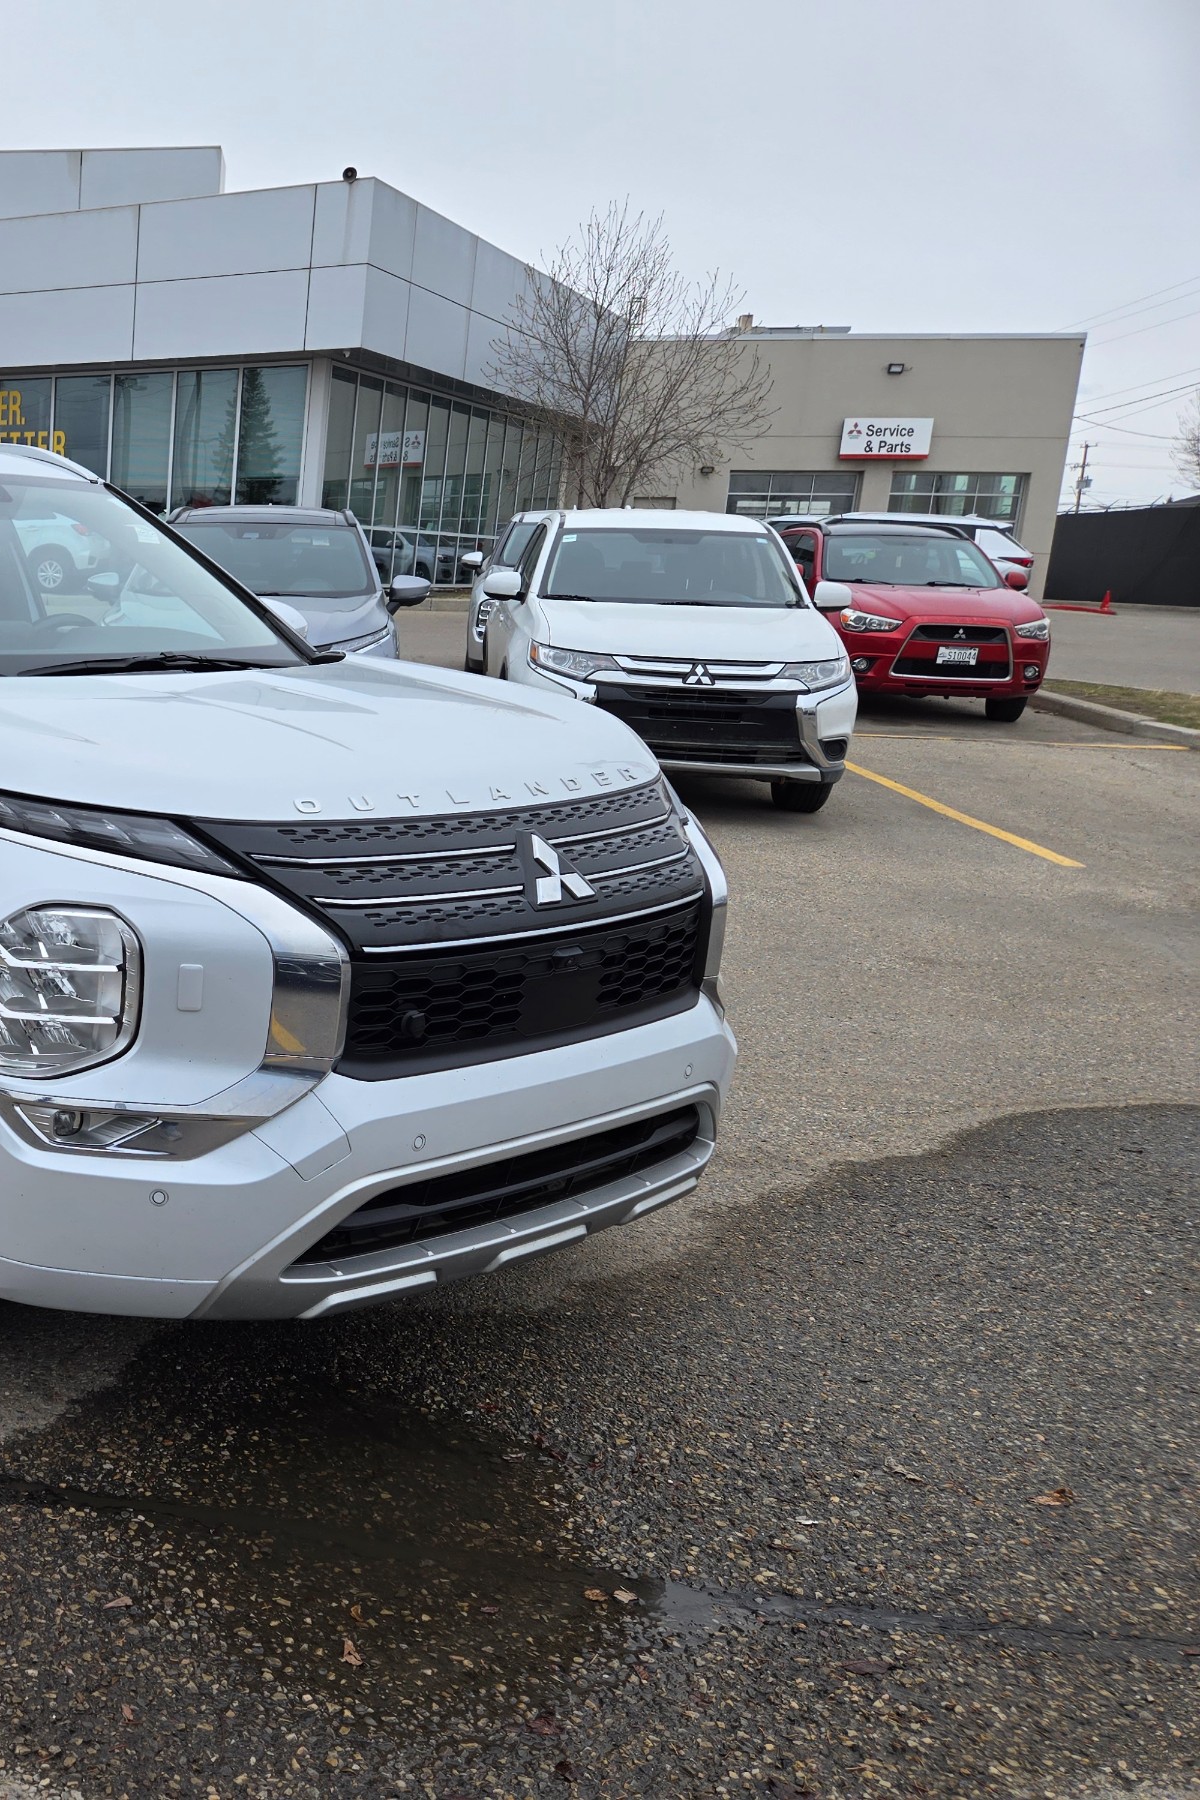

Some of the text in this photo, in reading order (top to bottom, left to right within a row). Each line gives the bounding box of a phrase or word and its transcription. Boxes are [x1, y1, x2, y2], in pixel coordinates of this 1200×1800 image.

[866, 424, 914, 437] Service
[864, 440, 911, 453] & Parts
[293, 767, 640, 815] OUTLANDER
